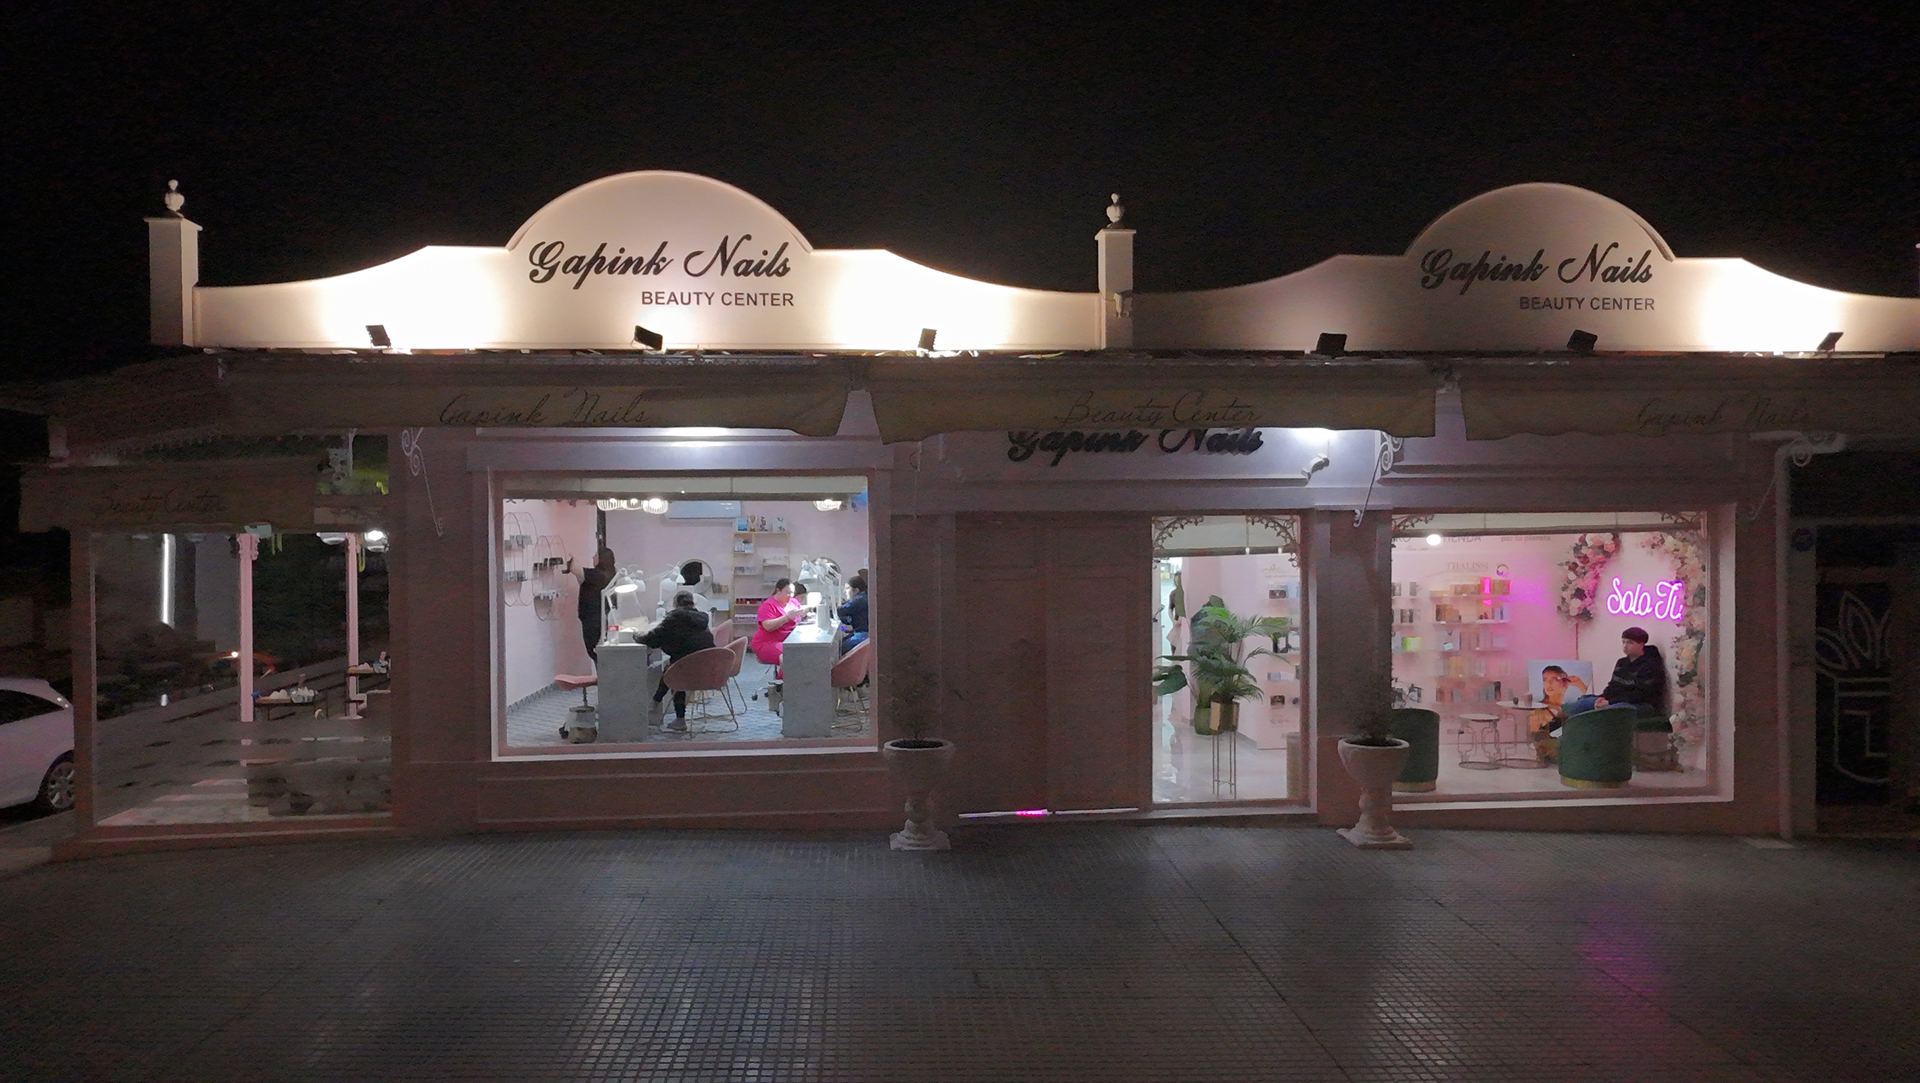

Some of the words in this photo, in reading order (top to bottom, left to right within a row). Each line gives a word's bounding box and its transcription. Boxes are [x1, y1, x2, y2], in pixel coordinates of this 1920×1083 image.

[529, 240, 673, 290] Gapink
[683, 234, 791, 278] Nails
[1420, 248, 1550, 296] Gapink
[1557, 242, 1653, 284] Nails
[641, 291, 716, 306] BEAUTY
[720, 292, 795, 307] CENTER
[1519, 296, 1587, 310] BEAUTY
[1589, 296, 1656, 311] CENTER
[1054, 390, 1170, 425] Beauty
[1171, 391, 1264, 424] Center
[1607, 577, 1653, 616] Solo
